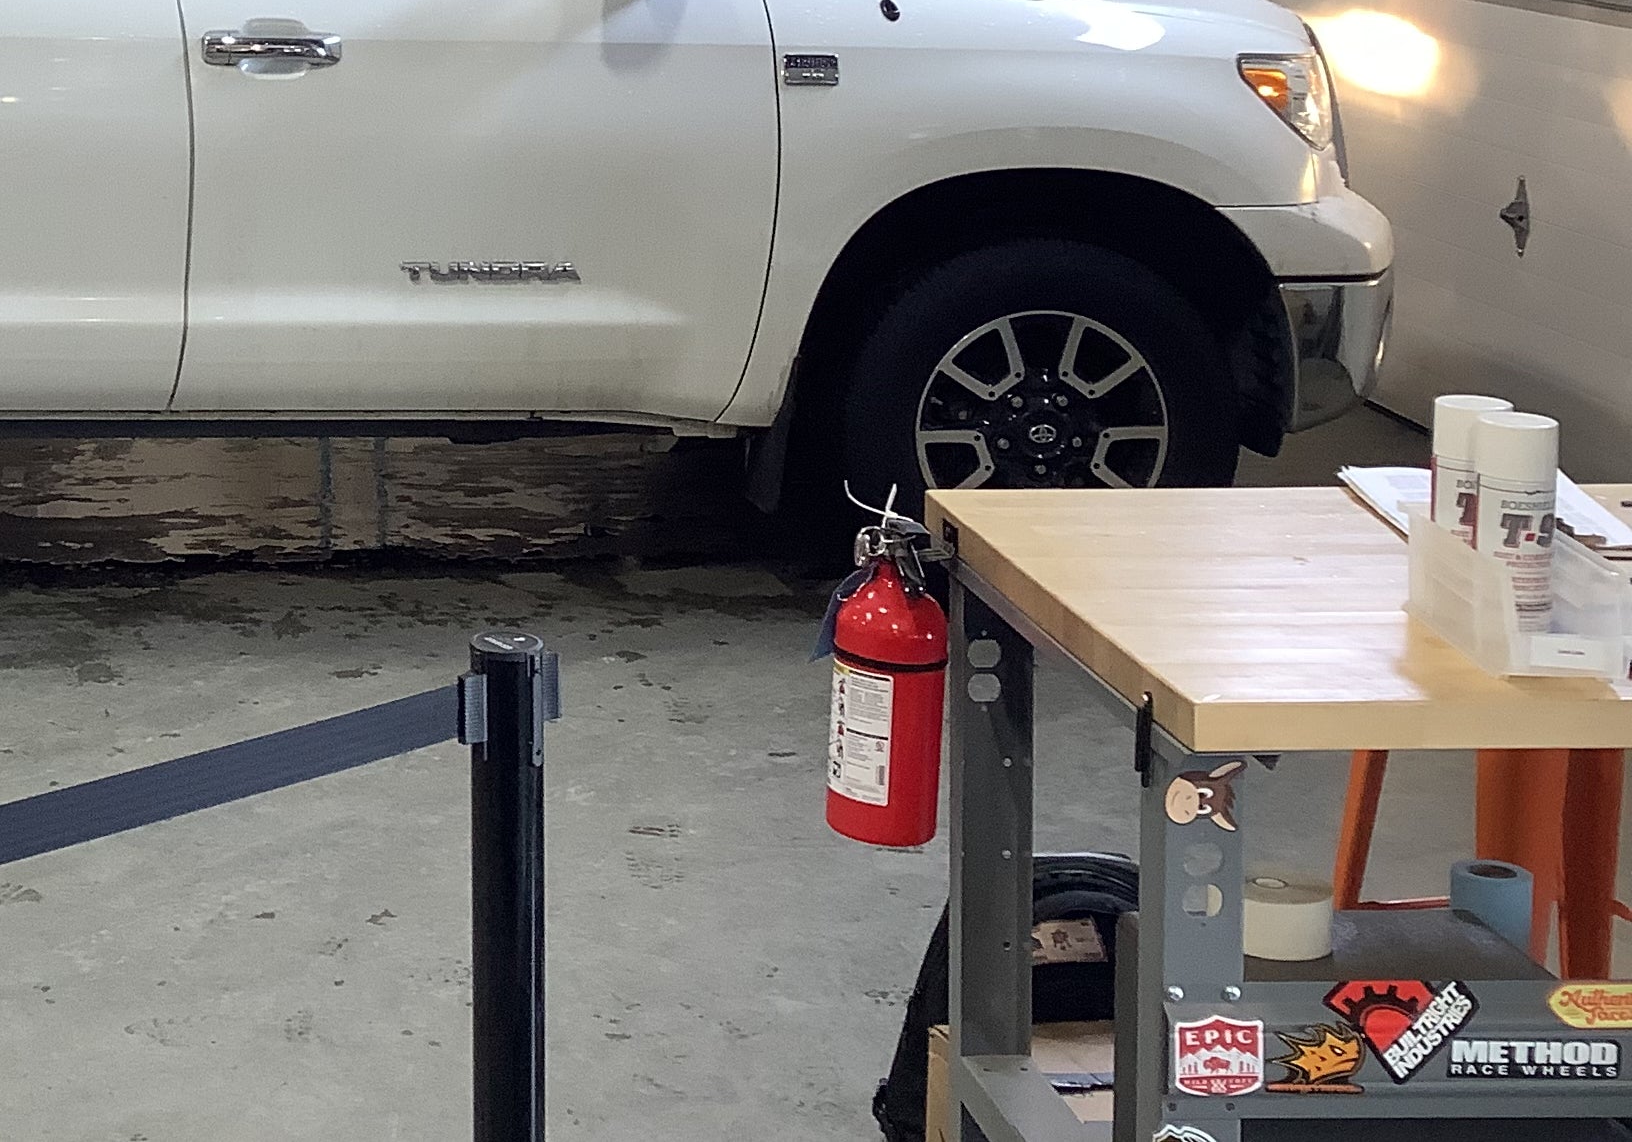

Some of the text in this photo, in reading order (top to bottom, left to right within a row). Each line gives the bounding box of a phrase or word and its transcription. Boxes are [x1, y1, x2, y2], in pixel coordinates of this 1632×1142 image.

[399, 260, 582, 285] TUNDRA
[1185, 1029, 1253, 1046] EPIC
[1393, 994, 1473, 1079] INDUSTRIES
[1451, 1040, 1618, 1064] METHOD
[1451, 1064, 1618, 1077] RACE WHEELS
